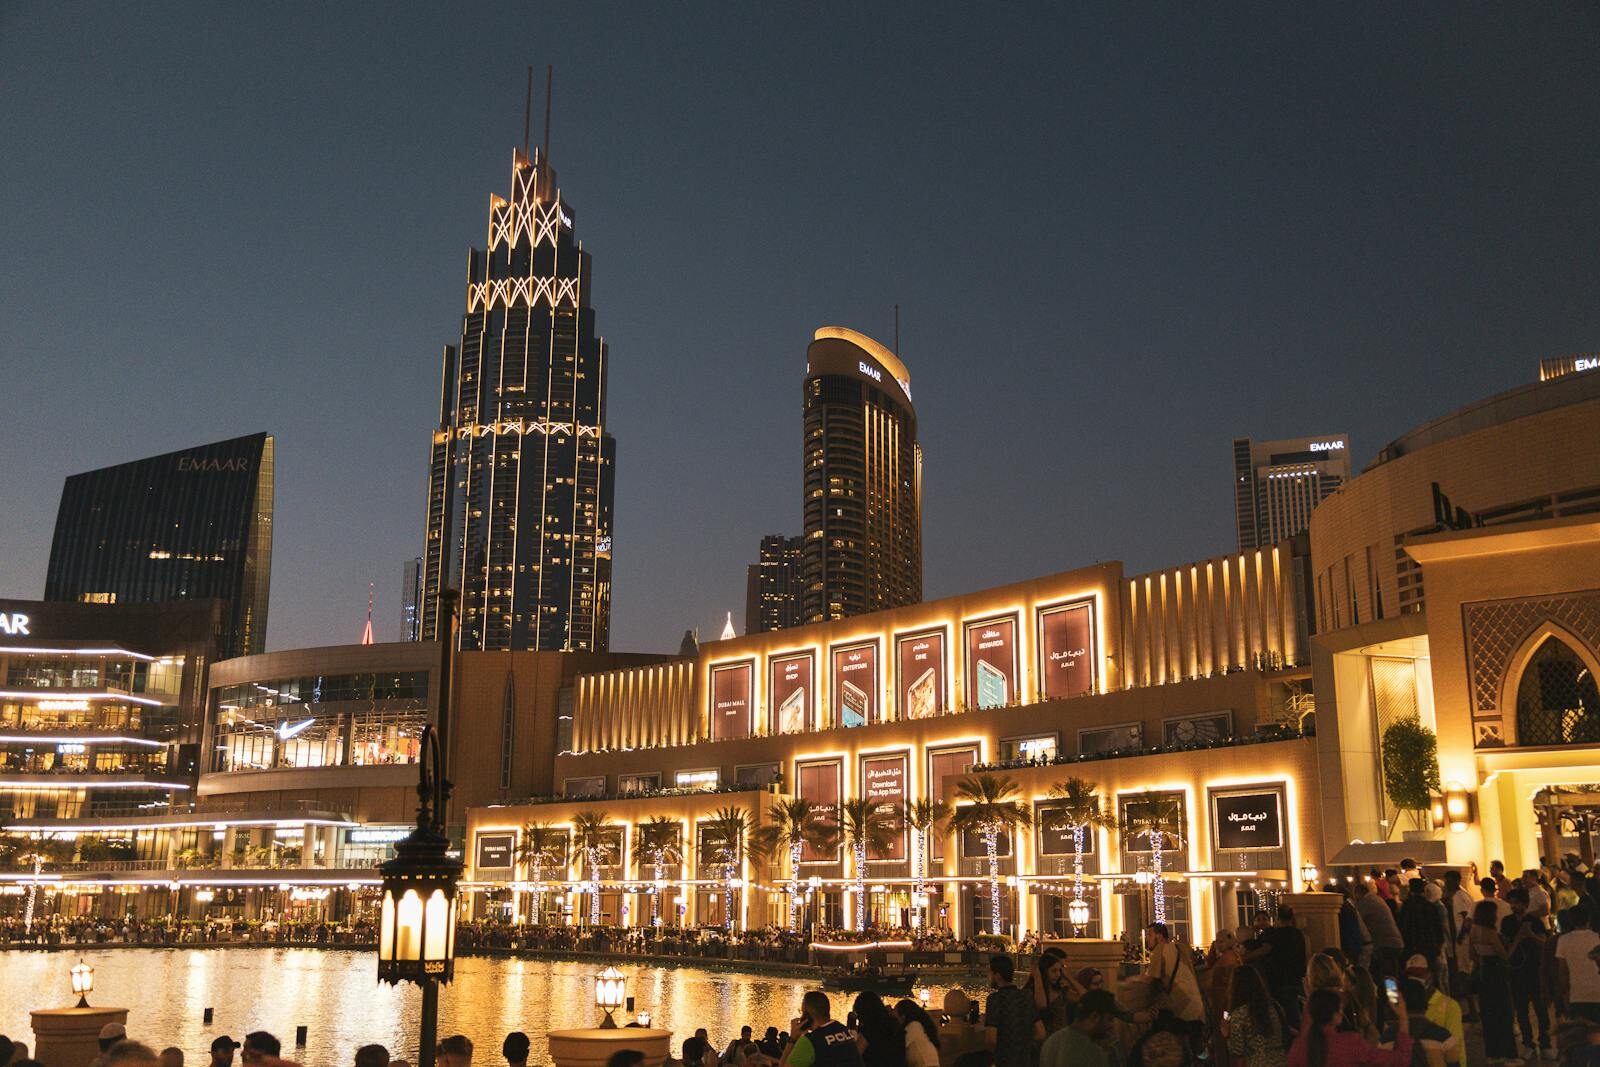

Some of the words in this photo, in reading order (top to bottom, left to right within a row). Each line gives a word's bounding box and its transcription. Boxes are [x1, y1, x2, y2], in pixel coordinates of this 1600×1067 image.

[1575, 358, 1600, 371] EM
[859, 361, 881, 382] EMAAR
[1310, 440, 1344, 452] EMAAR
[178, 457, 248, 471] EMAAR
[978, 639, 1004, 649] REWARDS
[872, 780, 897, 788] Download
[878, 789, 889, 797] App
